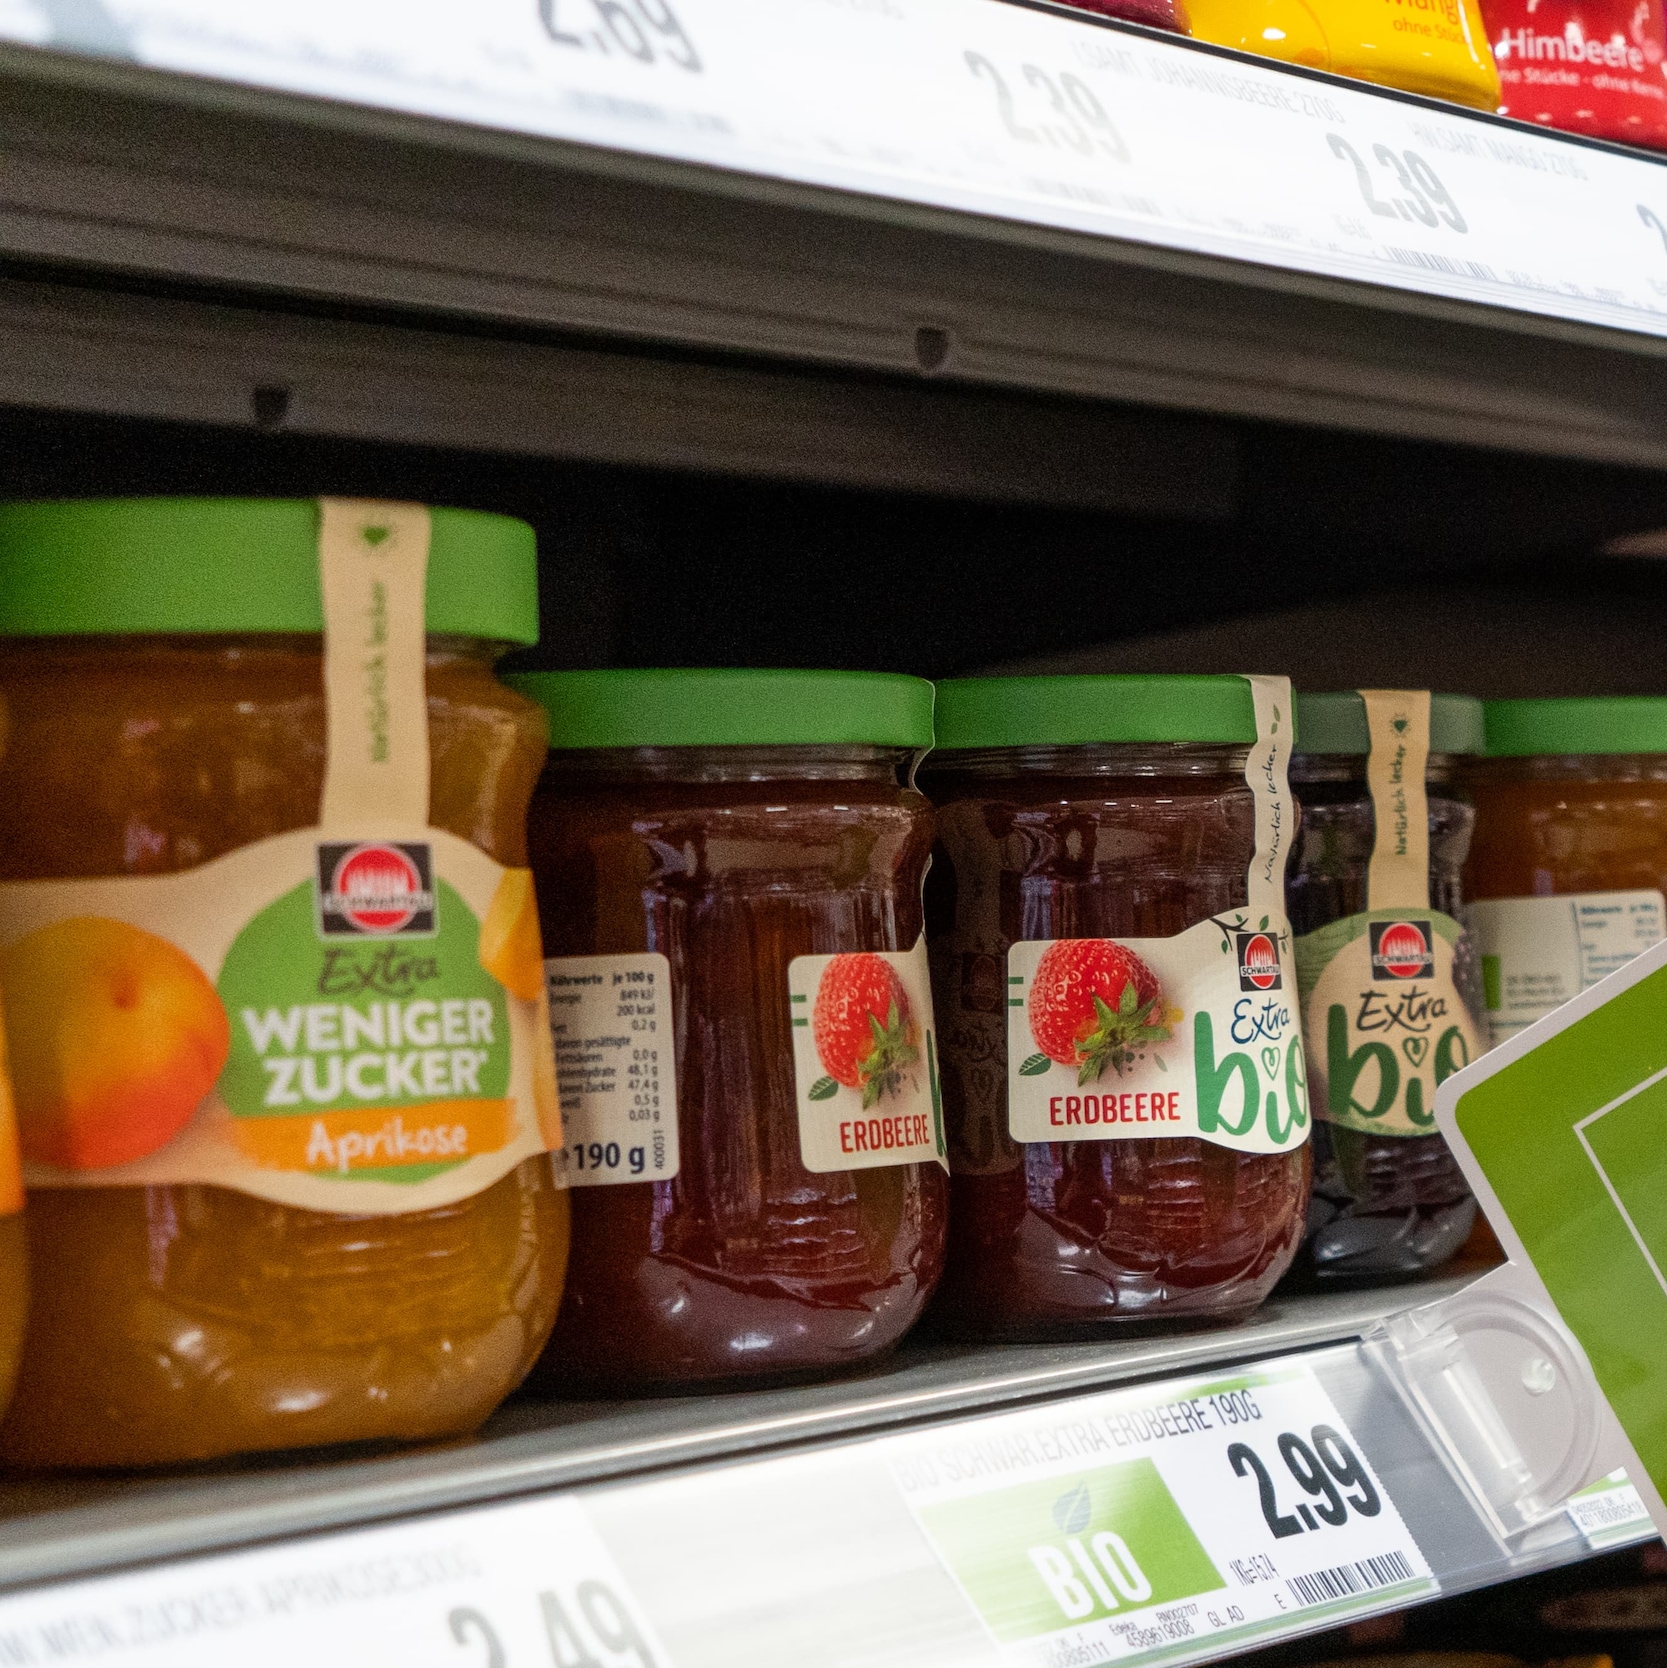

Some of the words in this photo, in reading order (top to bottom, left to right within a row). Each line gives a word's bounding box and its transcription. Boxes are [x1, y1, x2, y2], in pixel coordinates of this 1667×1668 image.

[1393, 17, 1431, 37] ohne
[1500, 24, 1645, 72] Himbeere
[962, 48, 1133, 166] 2.39
[1325, 132, 1469, 235] 2.39
[1261, 744, 1278, 795] lecker
[1264, 801, 1281, 883] Natürlich
[317, 942, 441, 999] Extra
[626, 971, 645, 983] 100
[1241, 965, 1280, 977] SCHWARTAU
[241, 998, 496, 1056] WENIGER
[617, 1004, 634, 1017] 200
[636, 1002, 656, 1015] kcal
[632, 1018, 647, 1031] 0,2
[1230, 996, 1292, 1045] Extra
[1356, 984, 1449, 1033] Extra
[627, 1079, 650, 1092] 47,4
[1194, 1010, 1308, 1146] bio
[839, 1113, 931, 1154] ERDBEERE
[1049, 1091, 1182, 1127] ERDBEERE
[306, 1118, 468, 1176] Aprikose
[573, 1141, 620, 1170] 190
[628, 1145, 646, 1175] g
[944, 1421, 1108, 1484] SCHWAR.EXTRA
[1108, 1394, 1215, 1449] ERDBEERE
[1213, 1387, 1264, 1428] 190G
[1225, 1422, 1384, 1541] 2.99
[1026, 1530, 1153, 1620] BIO
[1109, 1620, 1139, 1636] Edeka
[1155, 1603, 1200, 1623] RN002707
[1125, 1618, 1196, 1650] 4589619008
[1207, 1611, 1226, 1628] GL
[1226, 1604, 1245, 1622] AD
[1274, 1593, 1287, 1610] E
